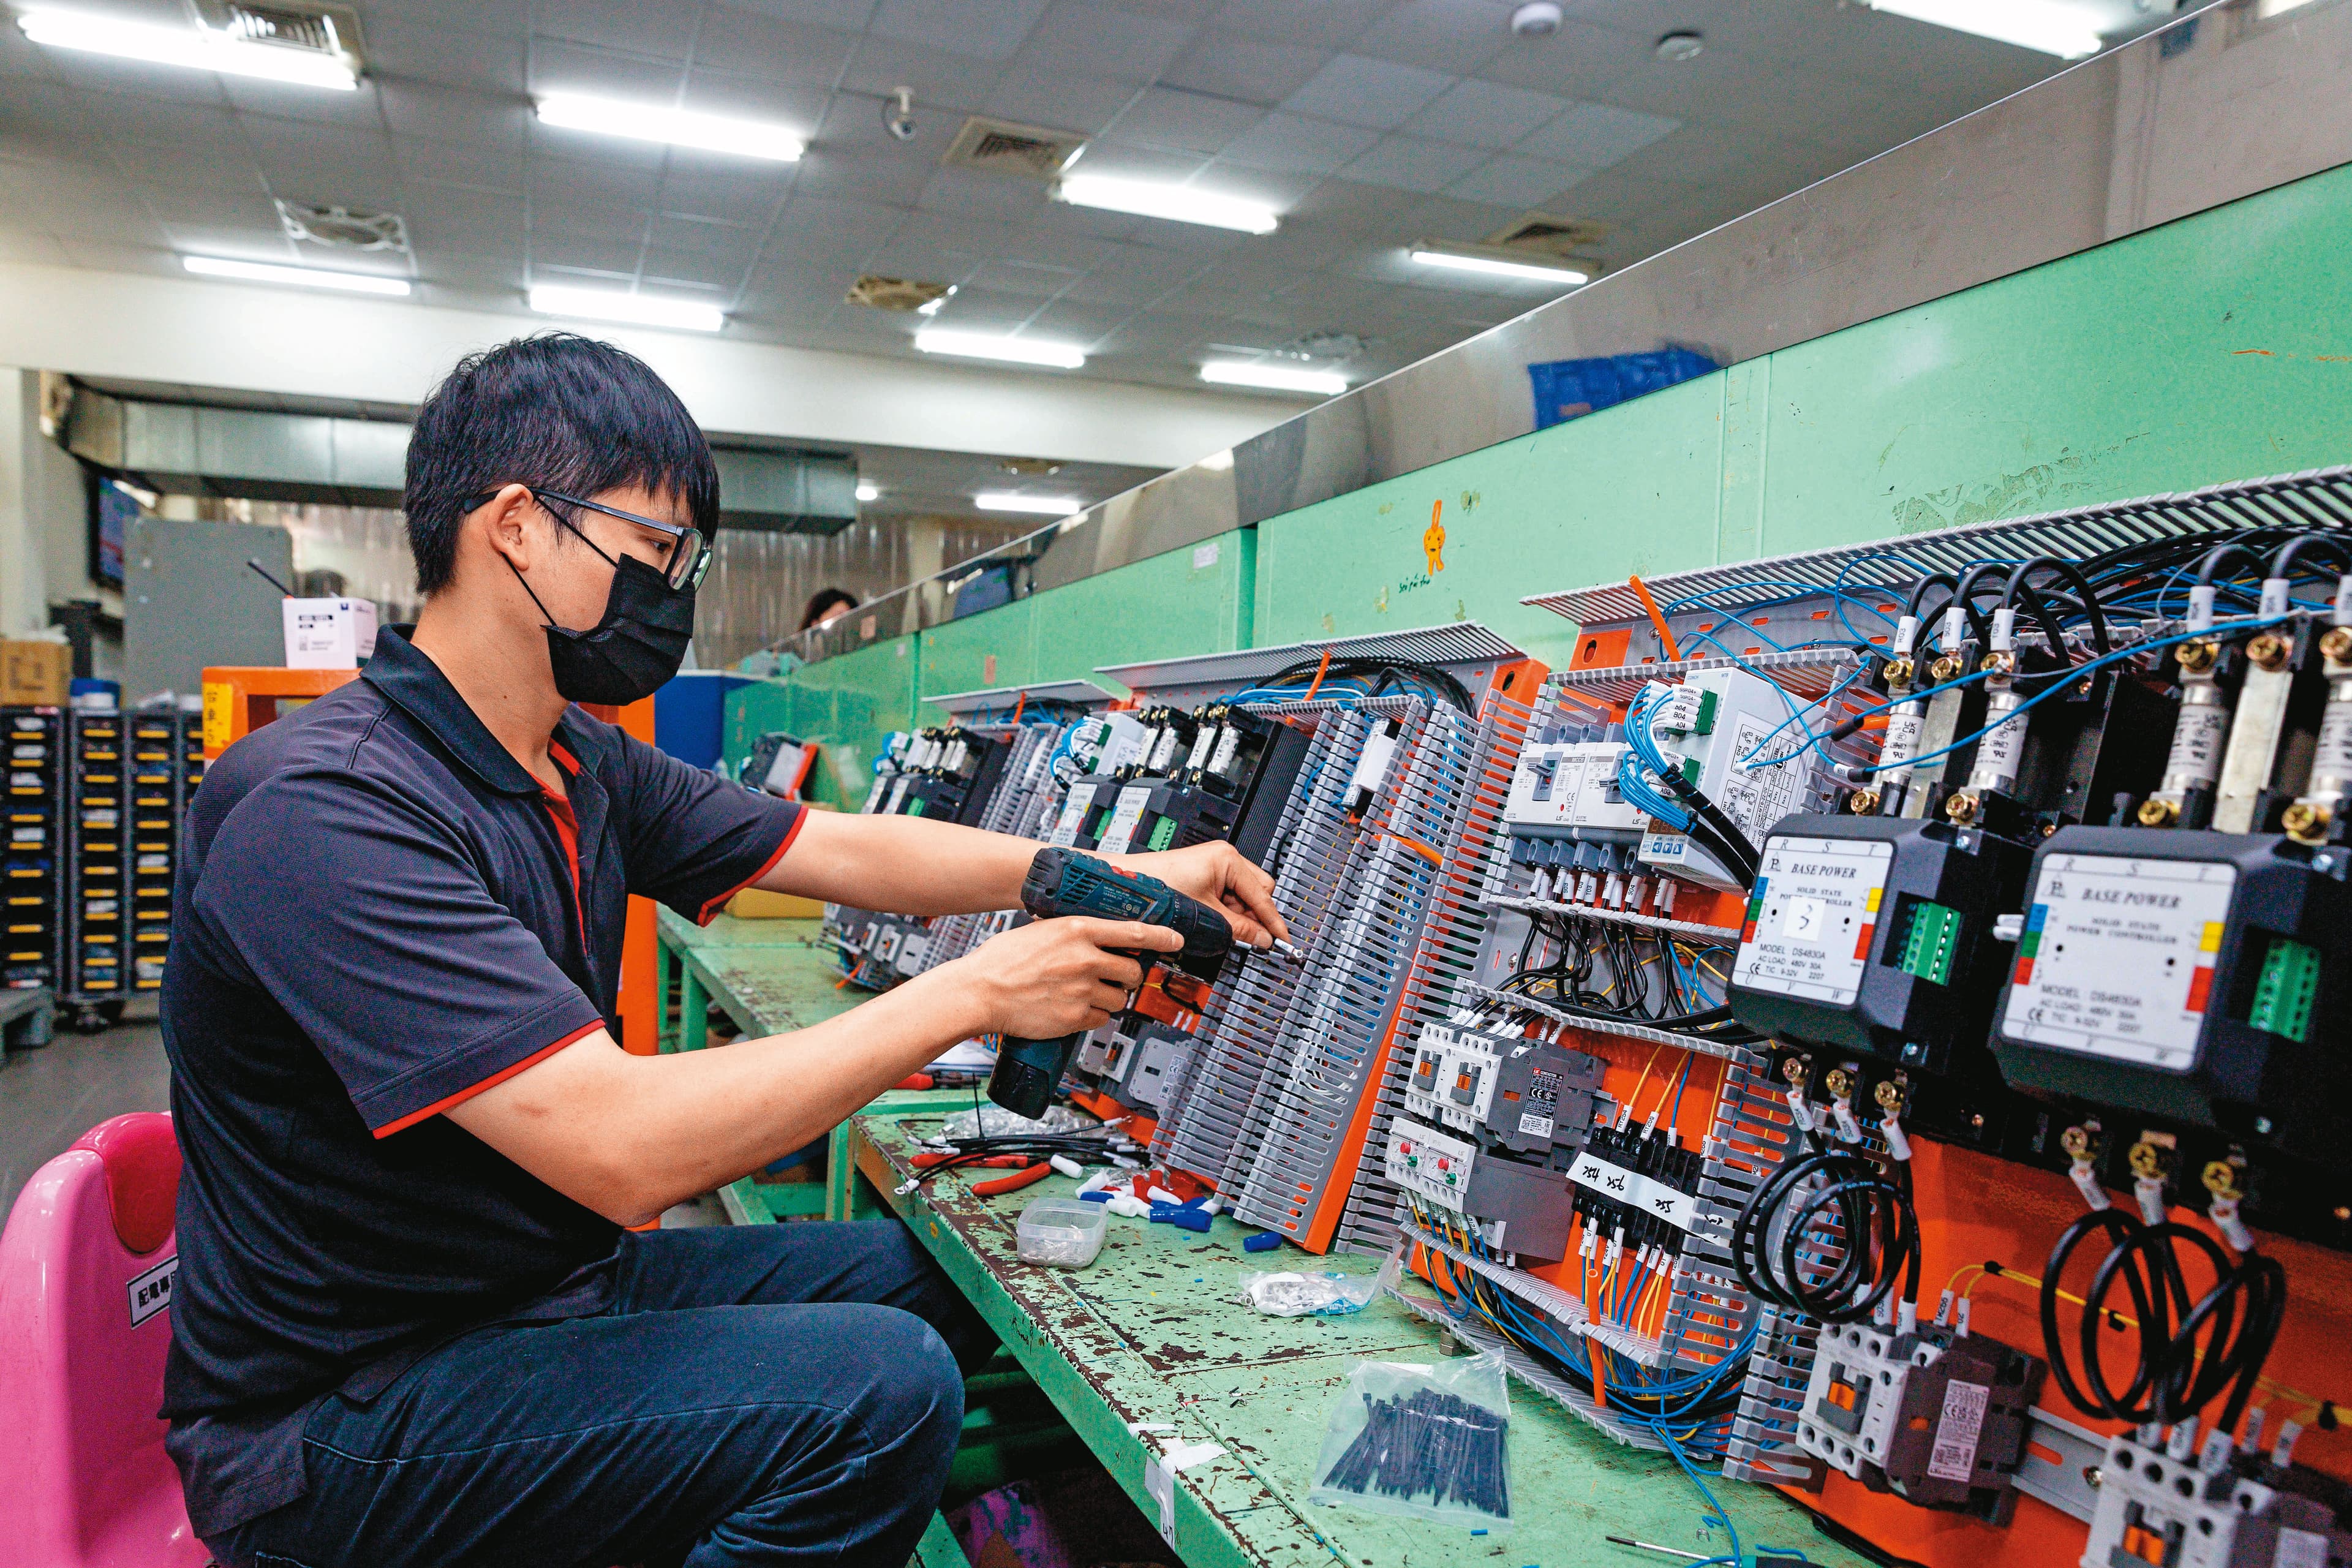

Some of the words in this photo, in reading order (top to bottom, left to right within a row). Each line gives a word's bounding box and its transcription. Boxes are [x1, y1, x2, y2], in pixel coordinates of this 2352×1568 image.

[1781, 839, 1789, 850] R
[1823, 842, 1832, 853] S
[1869, 844, 1877, 856] T
[1791, 863, 1819, 875] BASE
[1819, 865, 1856, 878] POWER
[2082, 888, 2120, 903] BASE
[2124, 891, 2181, 908] POWER
[1759, 943, 1785, 954] MODEL
[1768, 956, 1786, 965] LOAD
